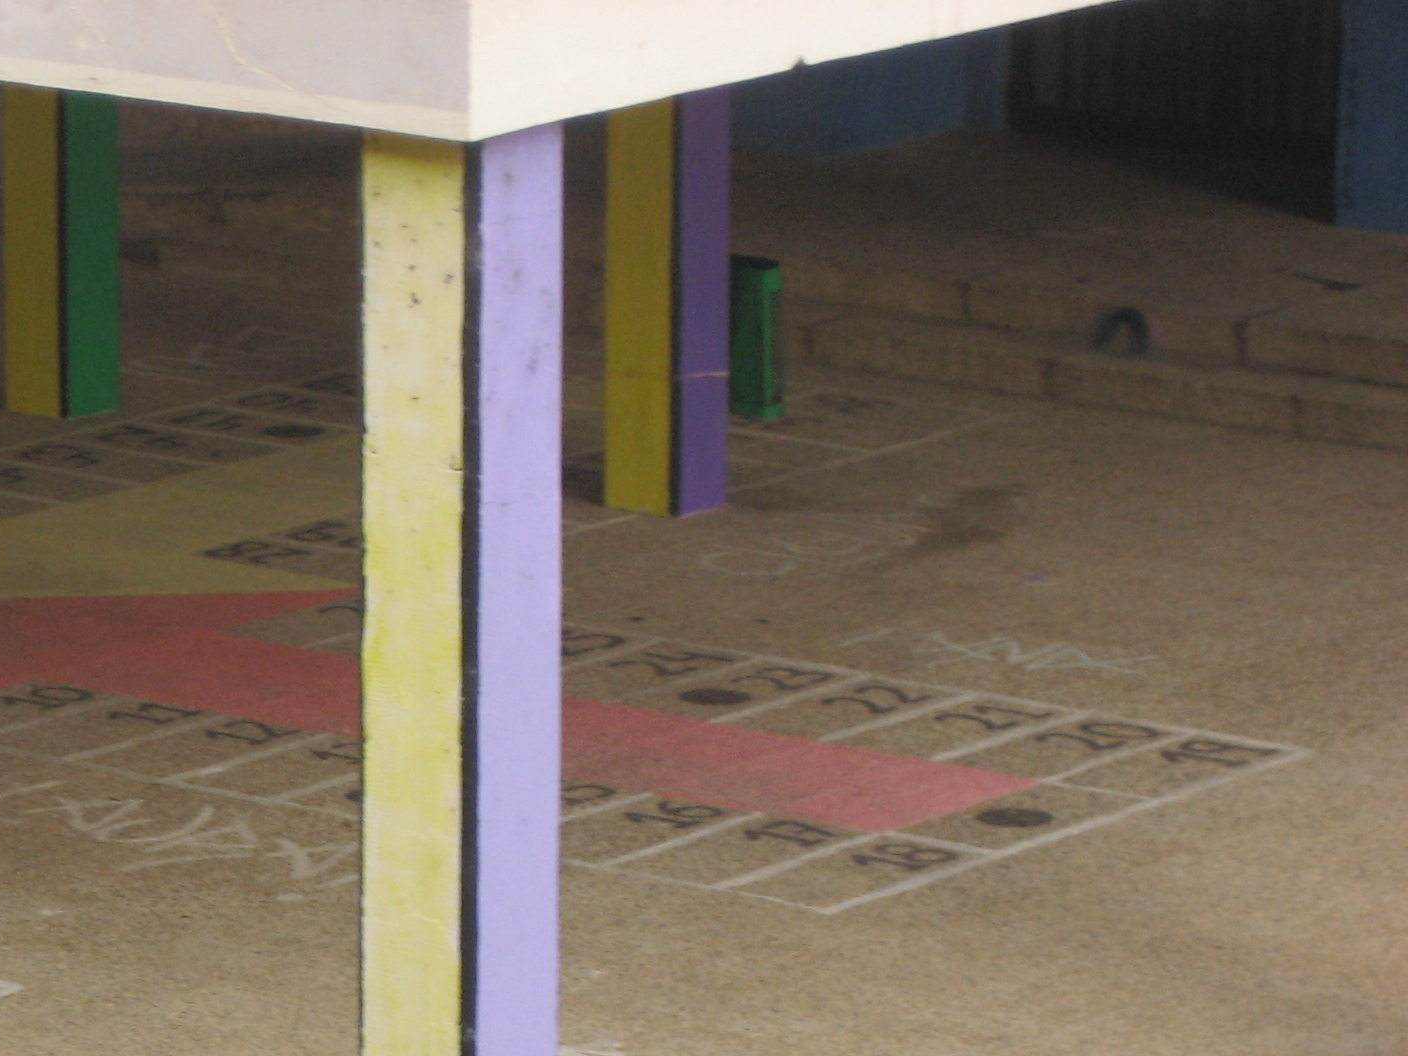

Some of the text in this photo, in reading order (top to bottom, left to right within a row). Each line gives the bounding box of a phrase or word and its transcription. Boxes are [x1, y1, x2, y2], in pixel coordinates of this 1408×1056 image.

[608, 649, 739, 677] 24
[731, 665, 835, 692] 23
[3, 684, 94, 712] 10
[107, 701, 206, 725] 11
[821, 685, 934, 716] 22
[205, 718, 303, 746] 12
[933, 703, 1061, 732] 21
[1033, 720, 1164, 752] 20
[1159, 738, 1281, 769] 19
[622, 798, 727, 829] 16
[743, 818, 836, 849] 17
[850, 840, 960, 871] 18
